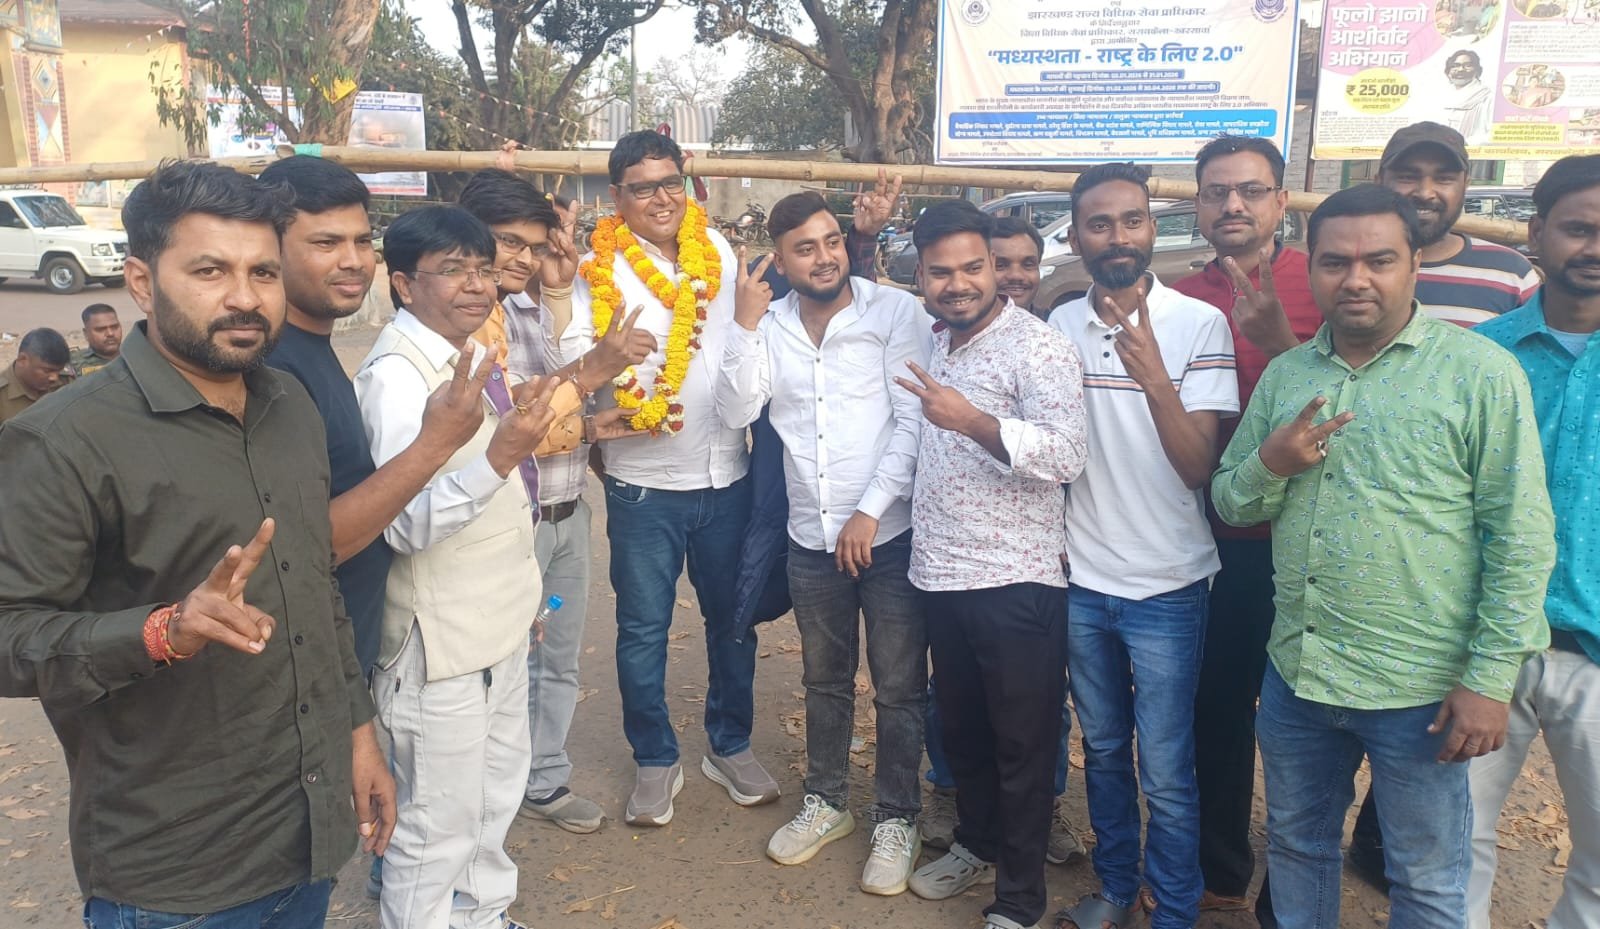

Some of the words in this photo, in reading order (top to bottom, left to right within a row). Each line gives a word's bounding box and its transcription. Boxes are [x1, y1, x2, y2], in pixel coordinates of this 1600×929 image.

[1027, 10, 1073, 20] झारखण्ड
[1075, 9, 1100, 19] राज्य
[1102, 7, 1136, 18] विधिक
[1138, 7, 1158, 17] सेवा
[1160, 6, 1206, 17] प्राधिकार
[1330, 3, 1376, 28] फूलो
[1380, 4, 1429, 24] झानो
[1329, 25, 1411, 46] आशीर्वाद
[1097, 47, 1134, 67] राष्ट्र
[1137, 43, 1157, 63] के
[1161, 42, 1199, 62] लिए
[1328, 47, 1409, 67] अभियान
[1359, 84, 1410, 97] 25,000
